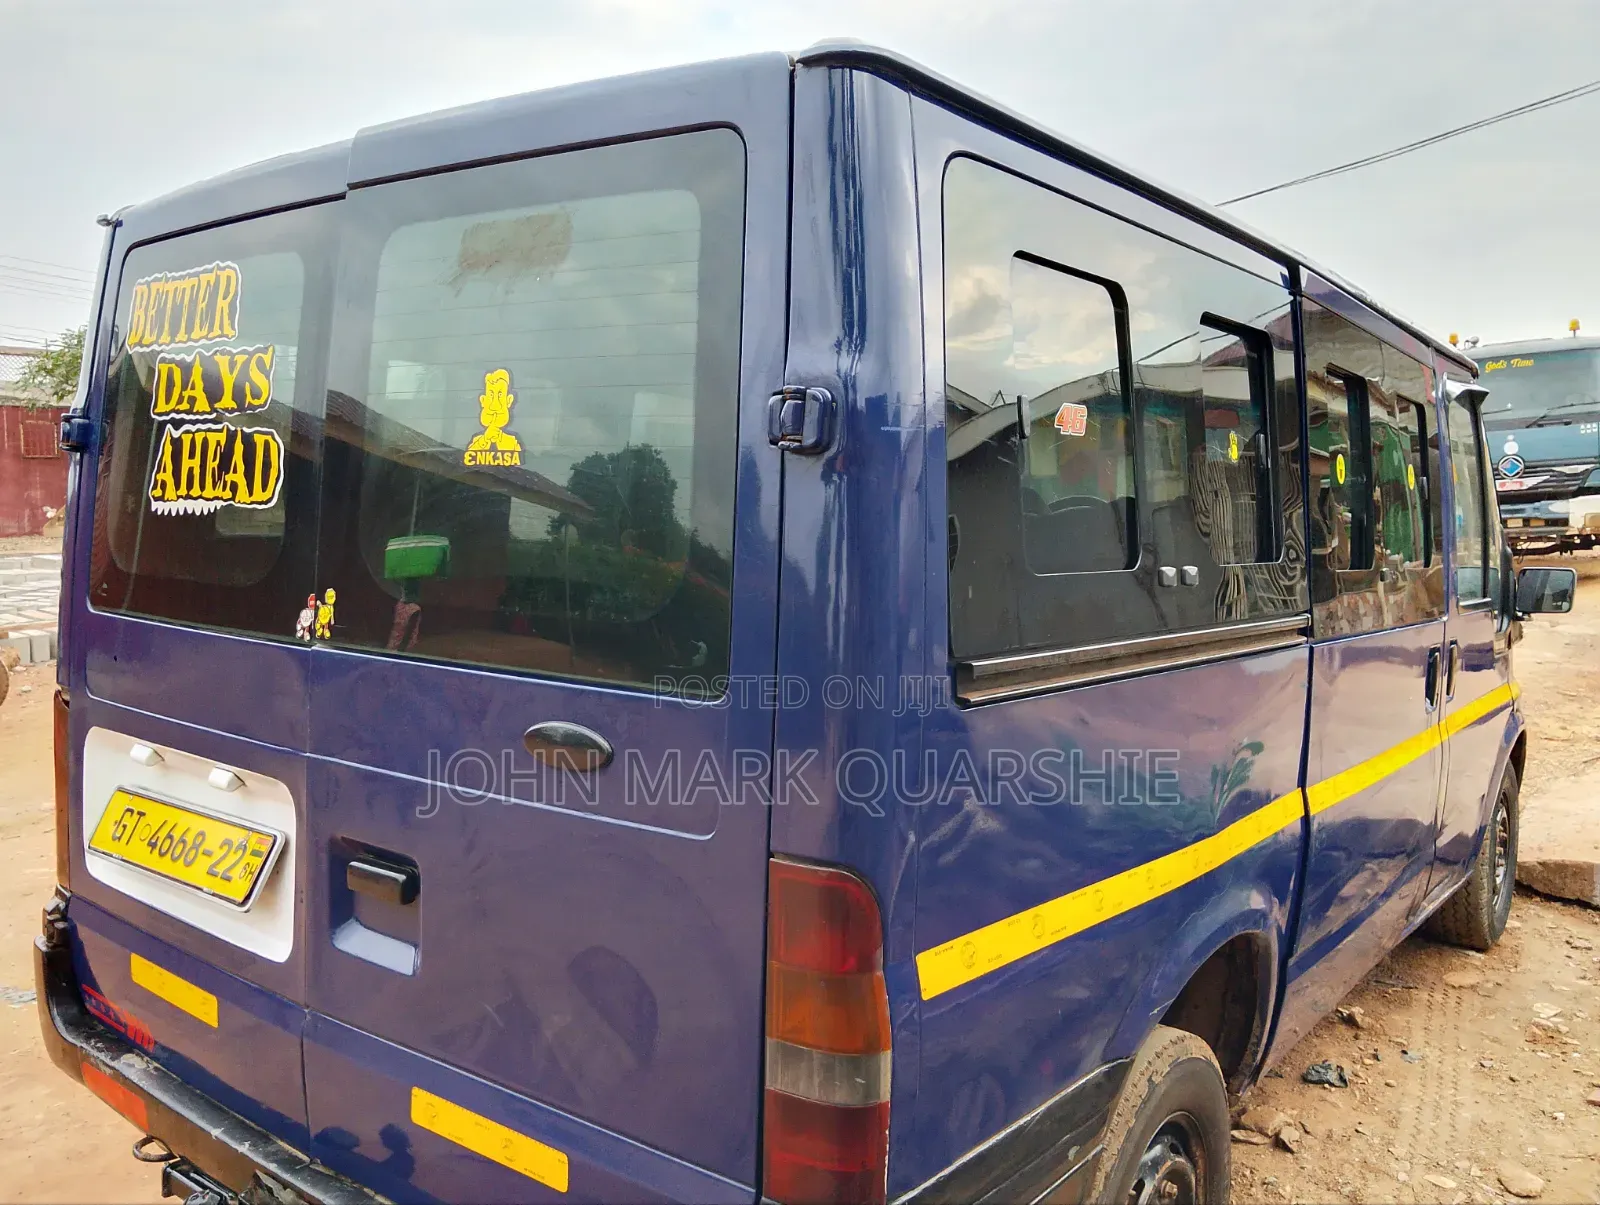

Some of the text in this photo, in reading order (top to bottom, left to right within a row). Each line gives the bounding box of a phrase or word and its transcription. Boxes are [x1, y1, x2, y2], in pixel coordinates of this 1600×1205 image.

[128, 266, 238, 347] BETTER
[154, 345, 275, 414] DAYS
[1511, 358, 1534, 368] Time
[151, 425, 279, 504] AHEAD
